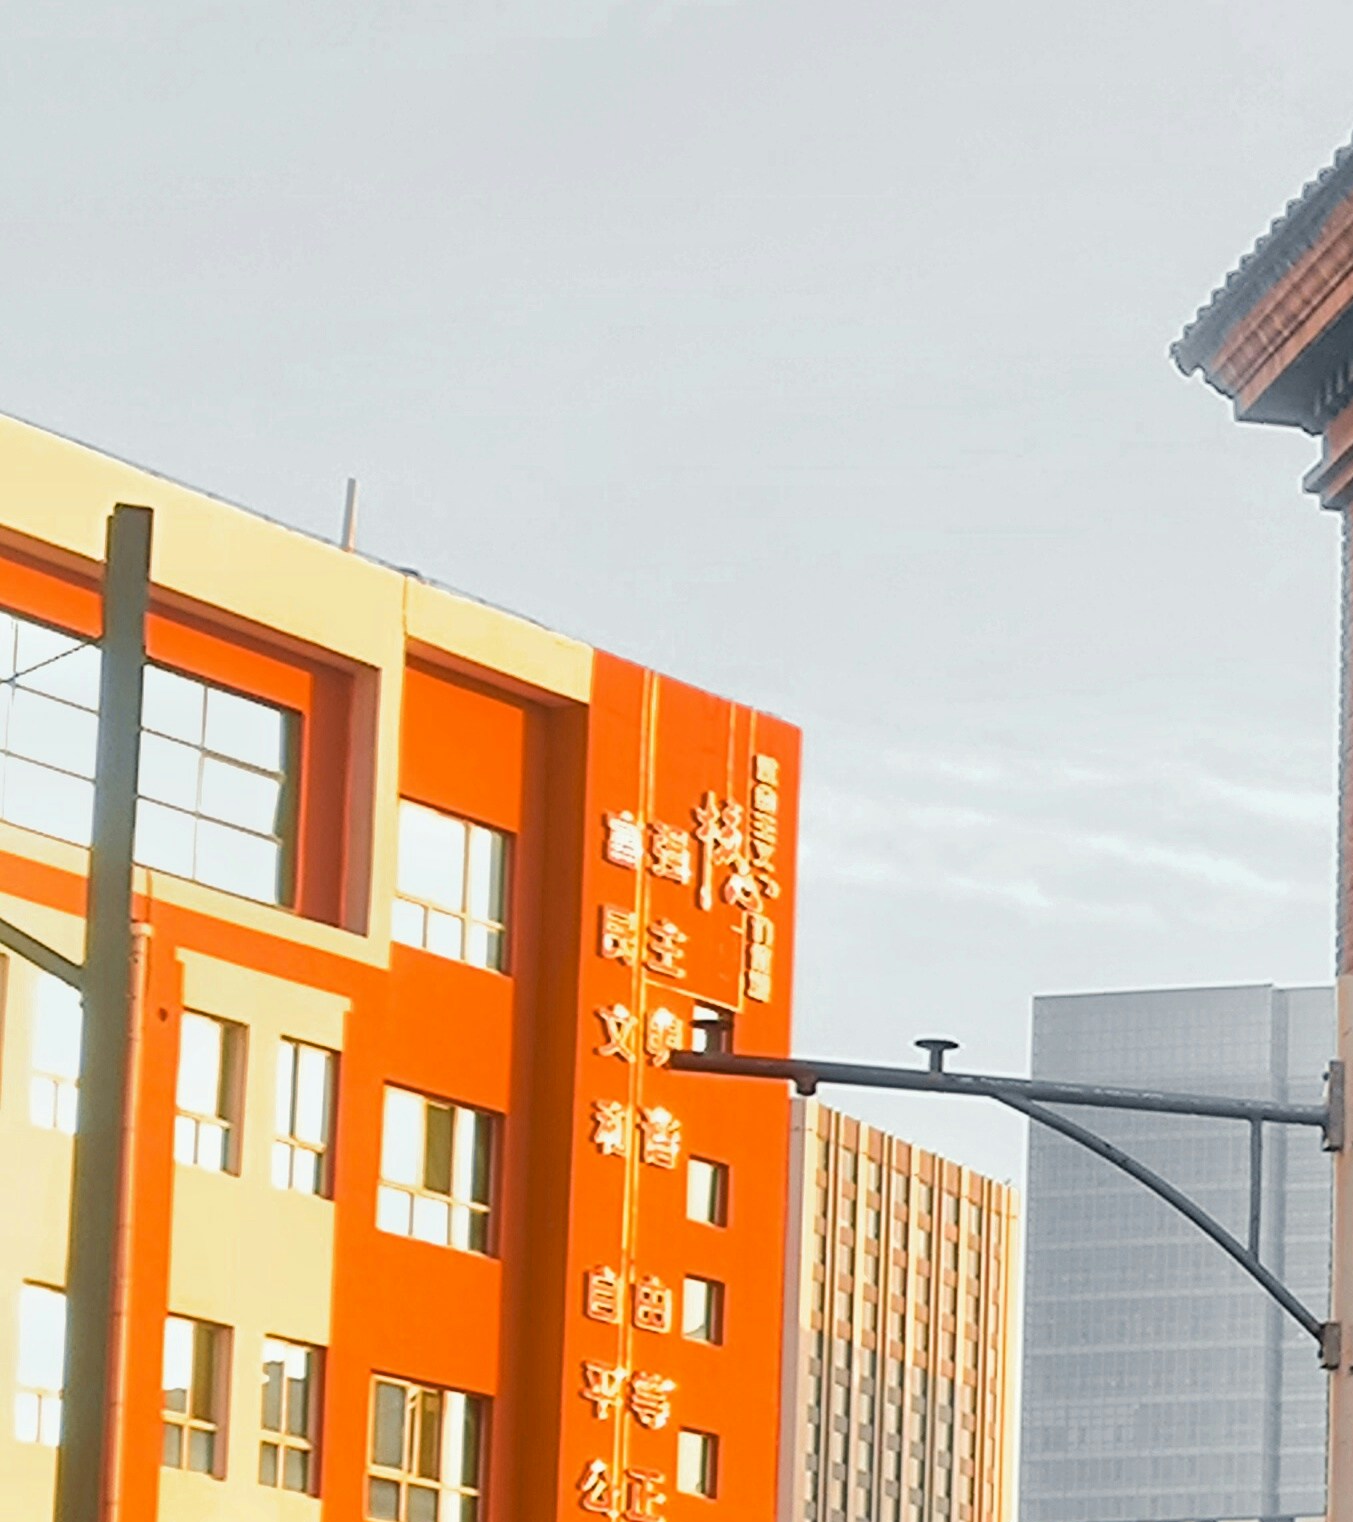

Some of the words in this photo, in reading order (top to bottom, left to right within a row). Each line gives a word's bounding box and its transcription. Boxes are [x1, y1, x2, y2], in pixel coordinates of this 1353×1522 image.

[601, 904, 687, 980] 民主
[599, 1003, 684, 1068] 文明
[586, 1265, 672, 1334] 自由
[580, 1359, 677, 1431] 平等
